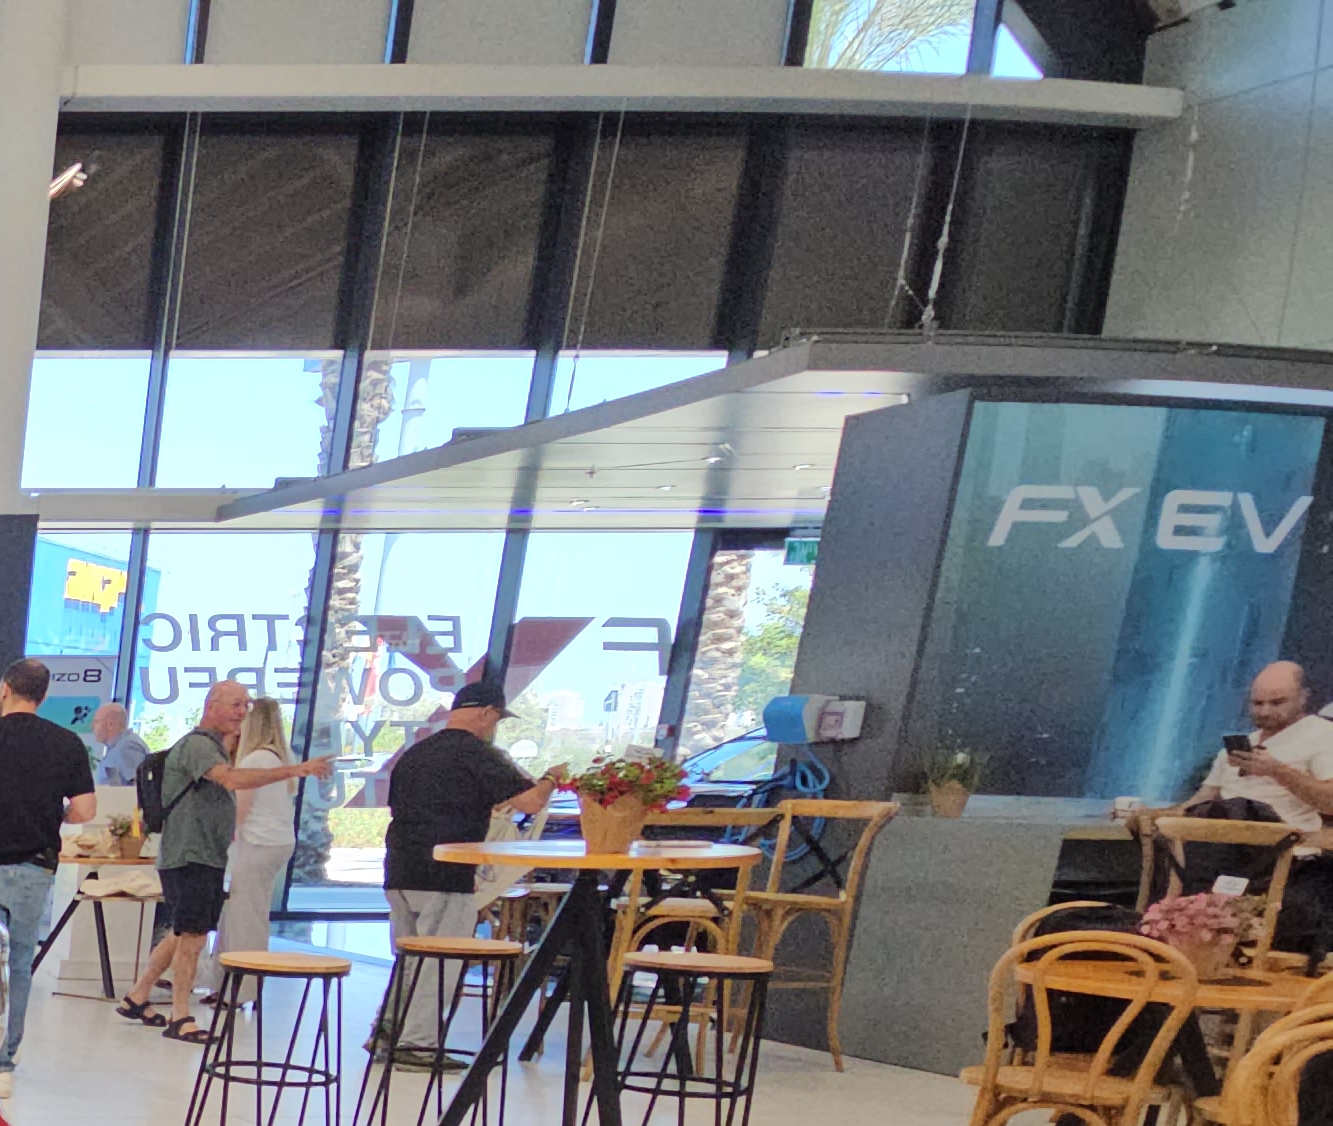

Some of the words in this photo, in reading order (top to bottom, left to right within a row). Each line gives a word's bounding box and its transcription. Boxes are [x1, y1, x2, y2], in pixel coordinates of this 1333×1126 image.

[986, 485, 1142, 548] FX
[1156, 489, 1314, 553] EV
[83, 669, 102, 683] 8
